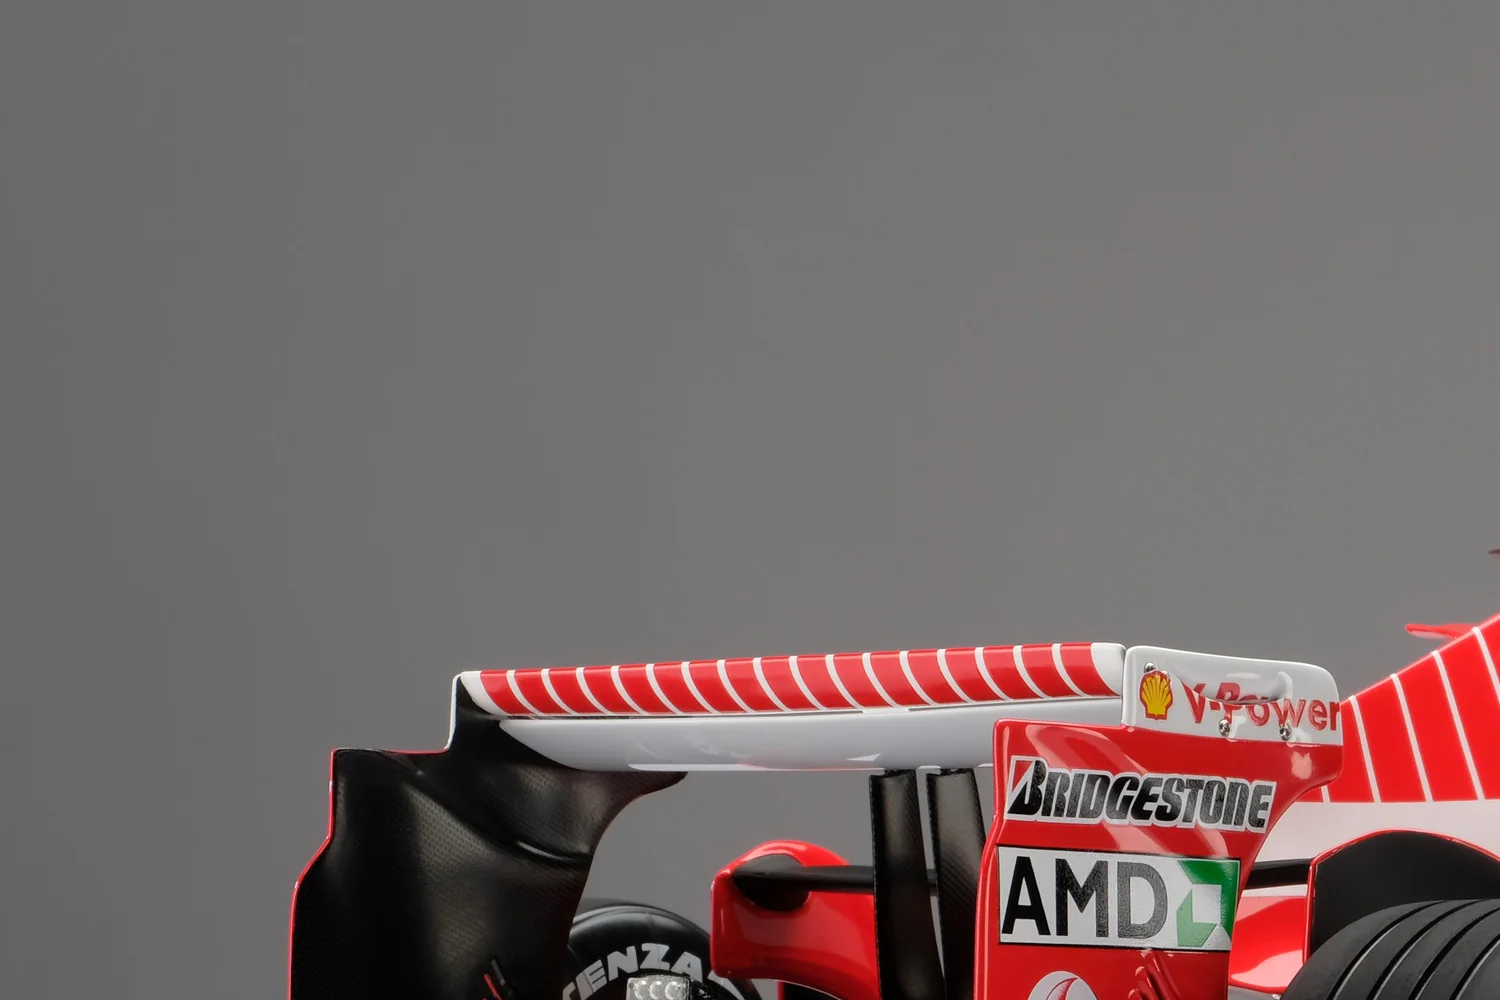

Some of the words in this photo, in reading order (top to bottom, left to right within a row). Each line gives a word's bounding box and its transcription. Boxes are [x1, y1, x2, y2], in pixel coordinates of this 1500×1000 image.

[1181, 682, 1340, 732] V-Power
[1006, 757, 1275, 830] BRIDGESTONE
[1002, 856, 1168, 939] AMD
